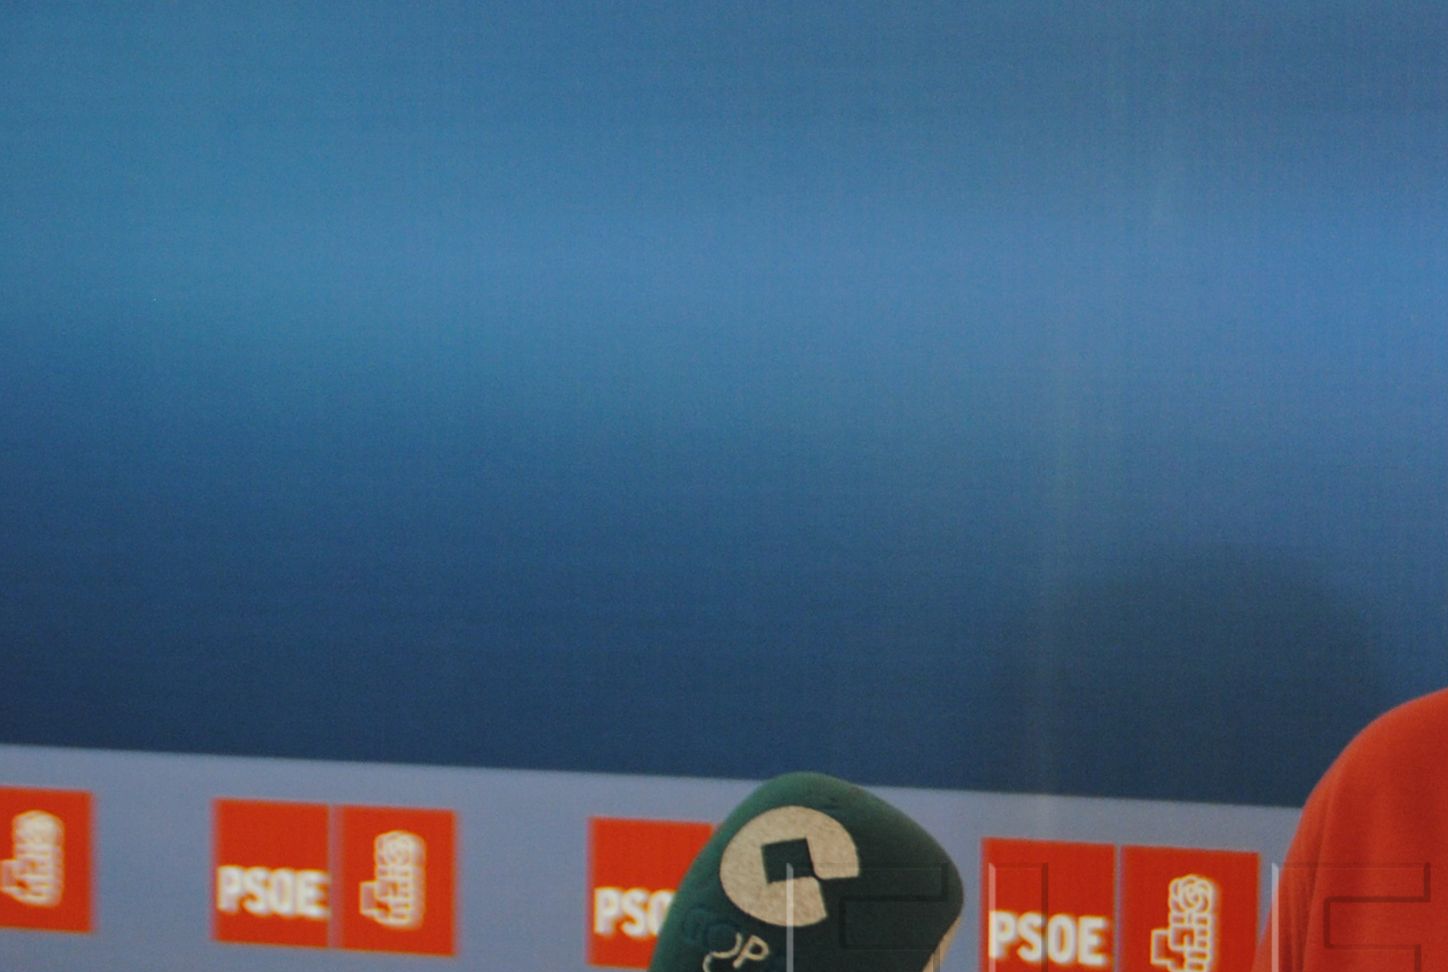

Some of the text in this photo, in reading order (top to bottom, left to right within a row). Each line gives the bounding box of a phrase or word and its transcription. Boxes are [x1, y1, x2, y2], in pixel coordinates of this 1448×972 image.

[216, 864, 330, 919] PSOE
[594, 886, 674, 937] PSO
[987, 909, 1110, 967] PSOE
